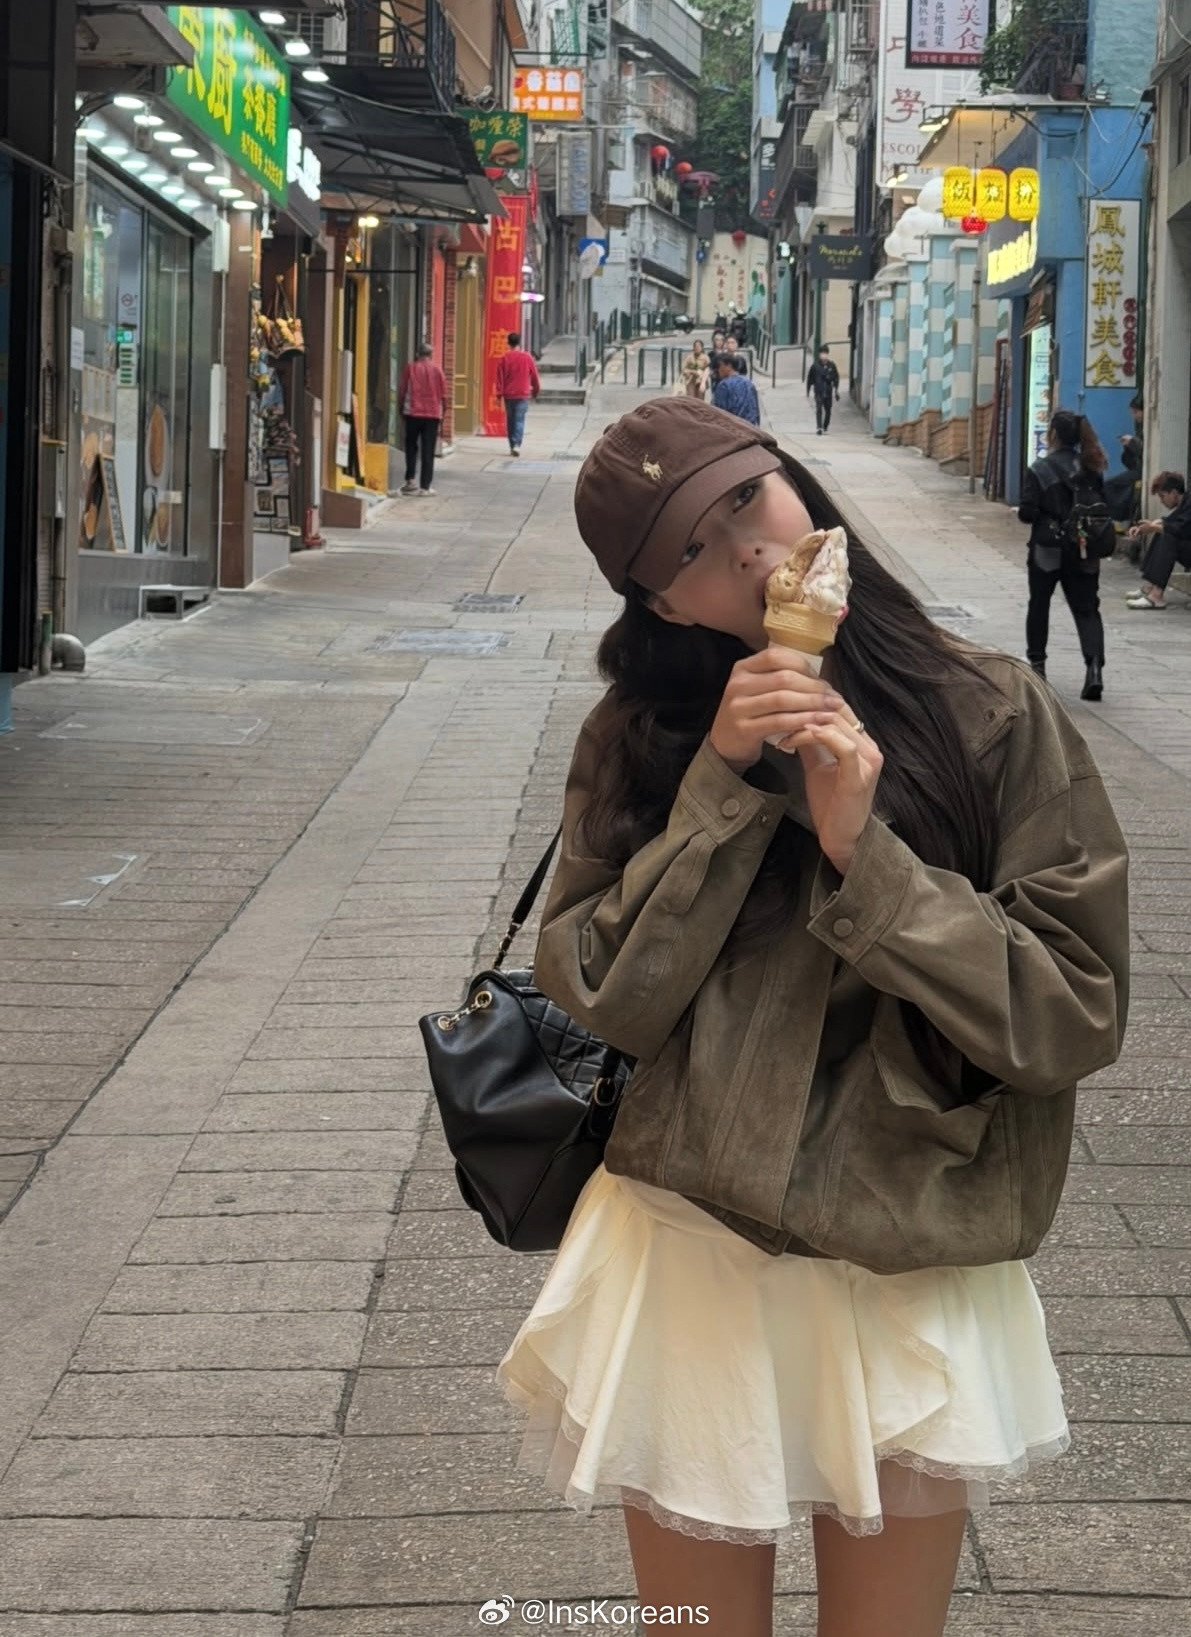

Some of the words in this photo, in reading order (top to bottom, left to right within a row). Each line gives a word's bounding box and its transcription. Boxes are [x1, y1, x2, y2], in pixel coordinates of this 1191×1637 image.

[953, 0, 983, 50] 美食
[1086, 206, 1126, 386] 鳳城軒美食
